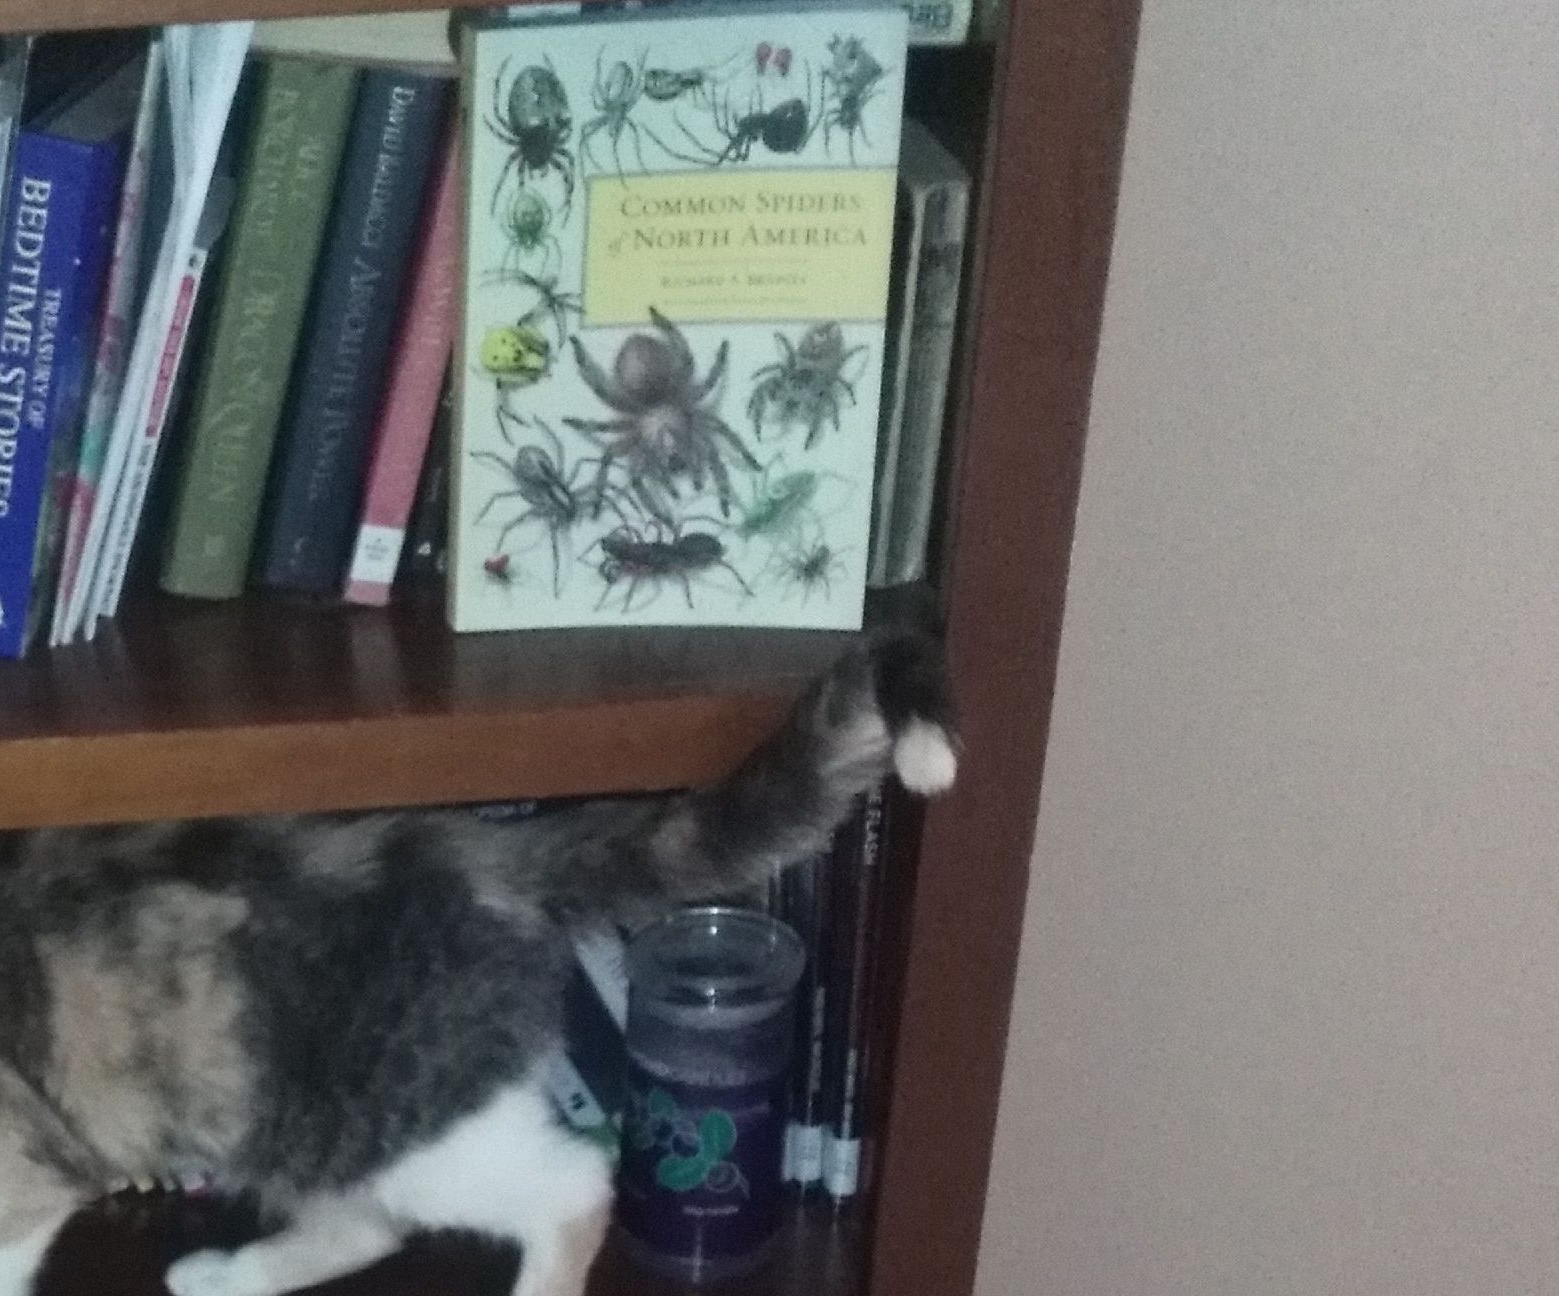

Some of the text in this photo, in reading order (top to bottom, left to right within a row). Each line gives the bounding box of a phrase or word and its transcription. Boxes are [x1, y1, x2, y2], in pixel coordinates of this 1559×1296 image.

[381, 83, 417, 152] DAVID
[621, 190, 862, 220] COMMON SPIDERS
[632, 227, 730, 250] NORTH
[744, 224, 868, 248] AMERICA
[2, 175, 51, 355] BEDTIME
[26, 288, 63, 430] TREASURY OF
